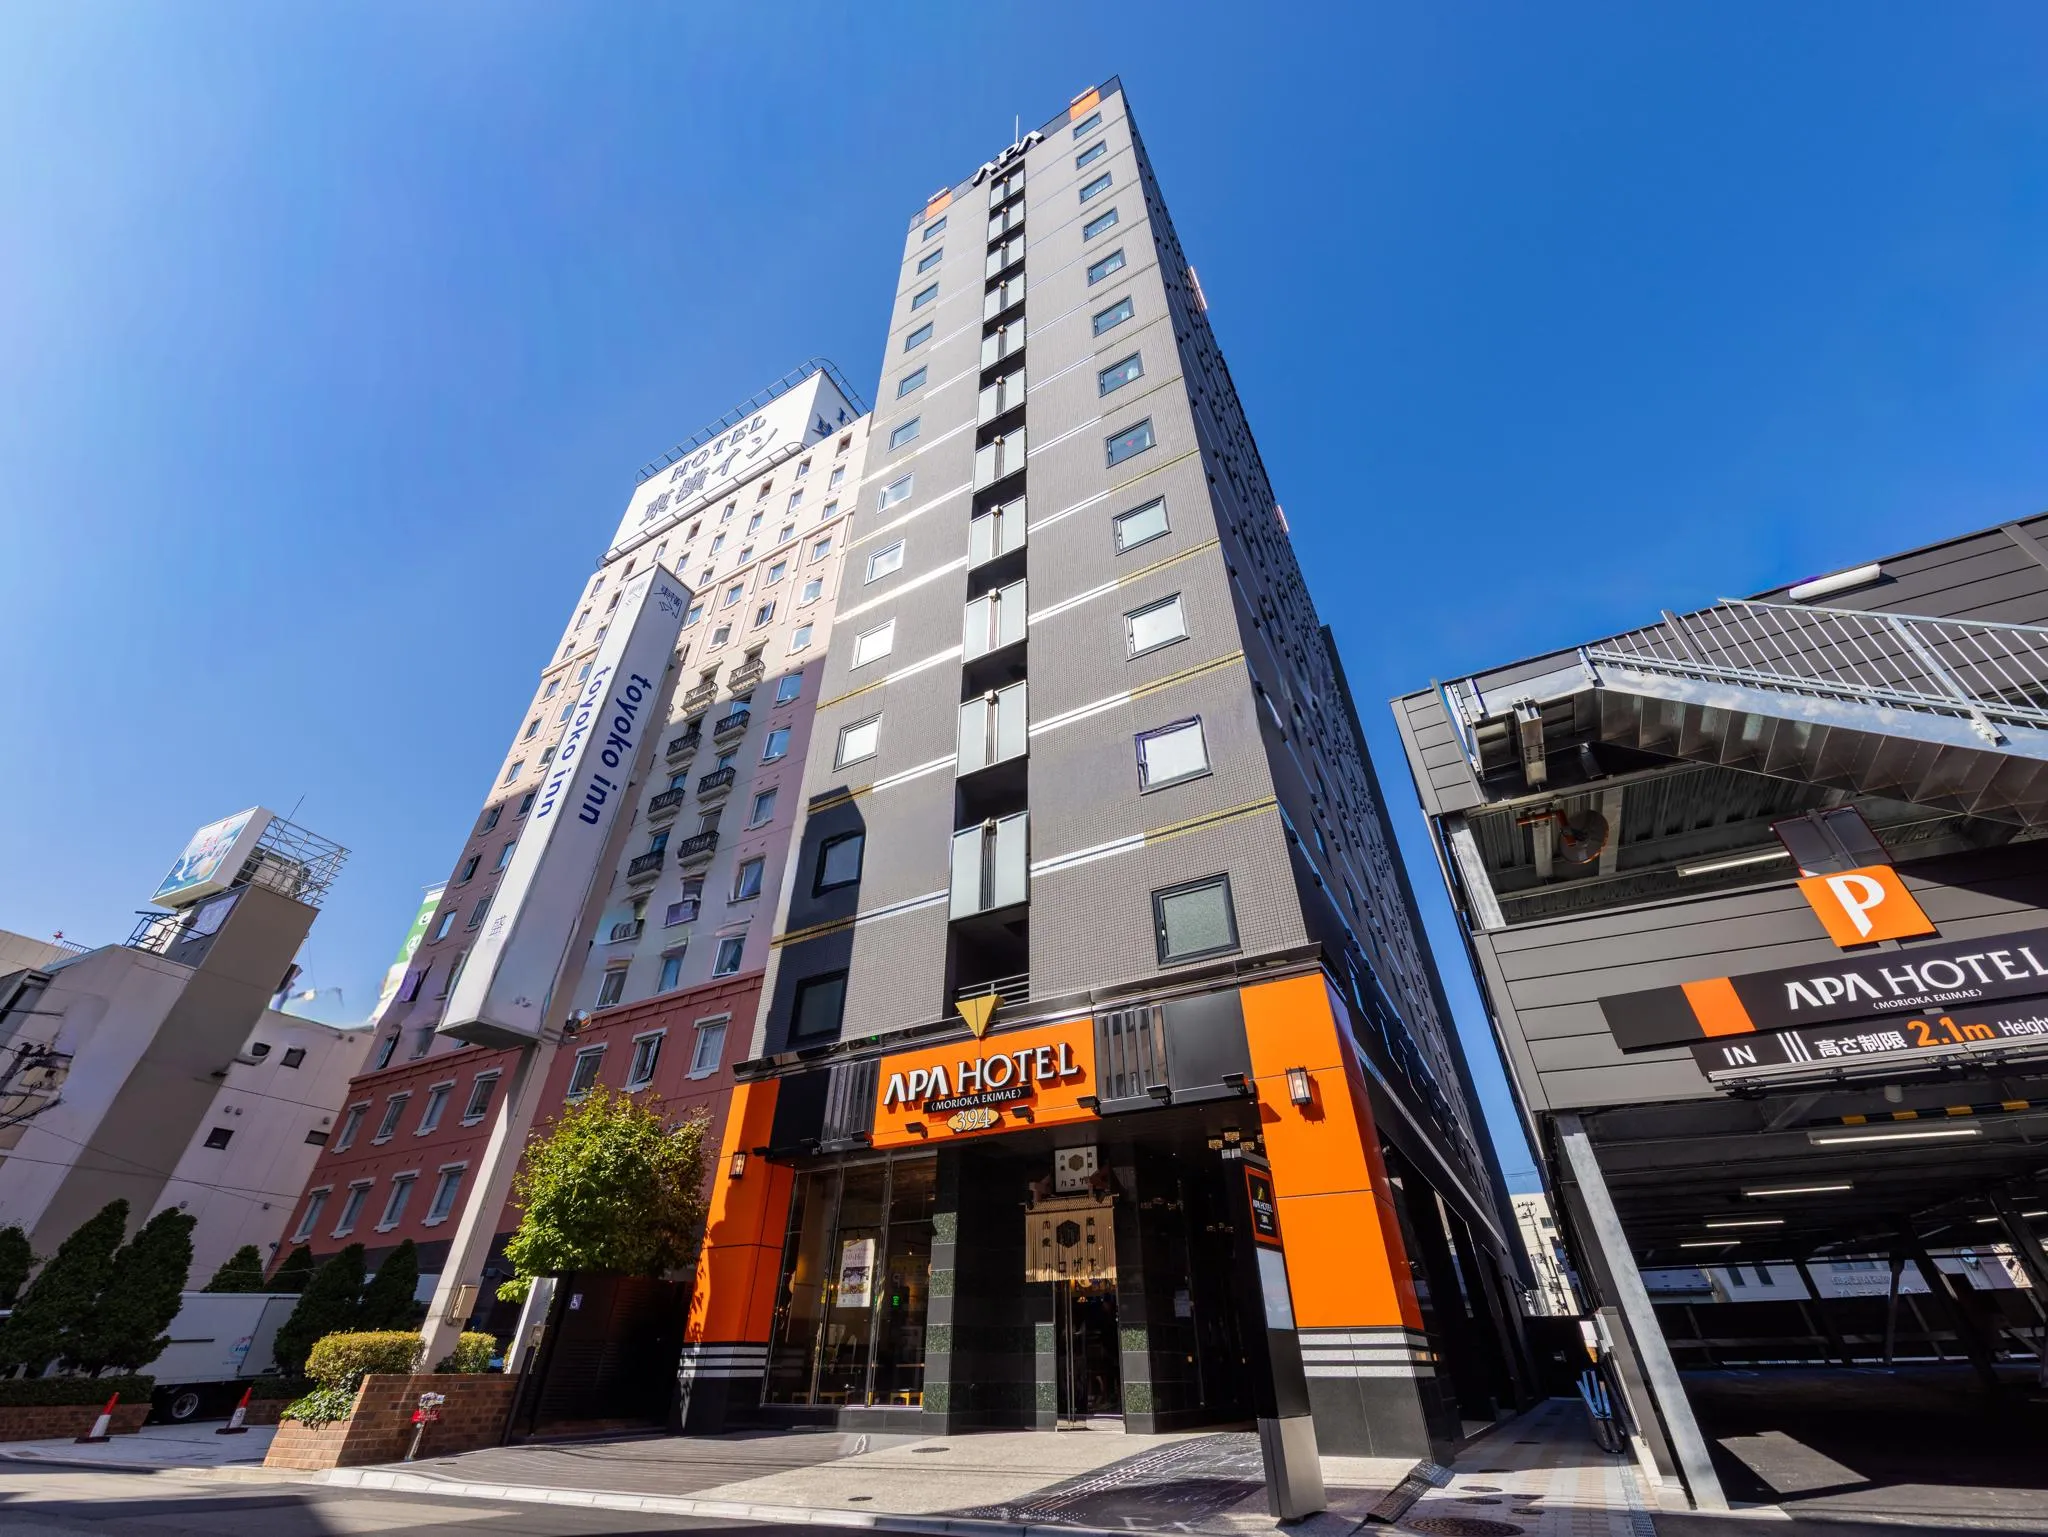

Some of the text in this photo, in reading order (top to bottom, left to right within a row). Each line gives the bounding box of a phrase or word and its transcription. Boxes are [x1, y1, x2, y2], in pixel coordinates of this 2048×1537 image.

[669, 415, 767, 483] HOTEL
[536, 664, 612, 819] toyoko inn
[578, 672, 652, 826] toyoko inn
[1826, 874, 1886, 938] P
[1784, 946, 2048, 1010] APA HOTEL
[883, 1042, 1079, 1105] APA HOTEL
[1722, 1045, 1757, 1066] IN
[1813, 1031, 1908, 1058] 高さ制限
[1907, 1017, 1995, 1047] 2.1m
[954, 1106, 992, 1133] 394
